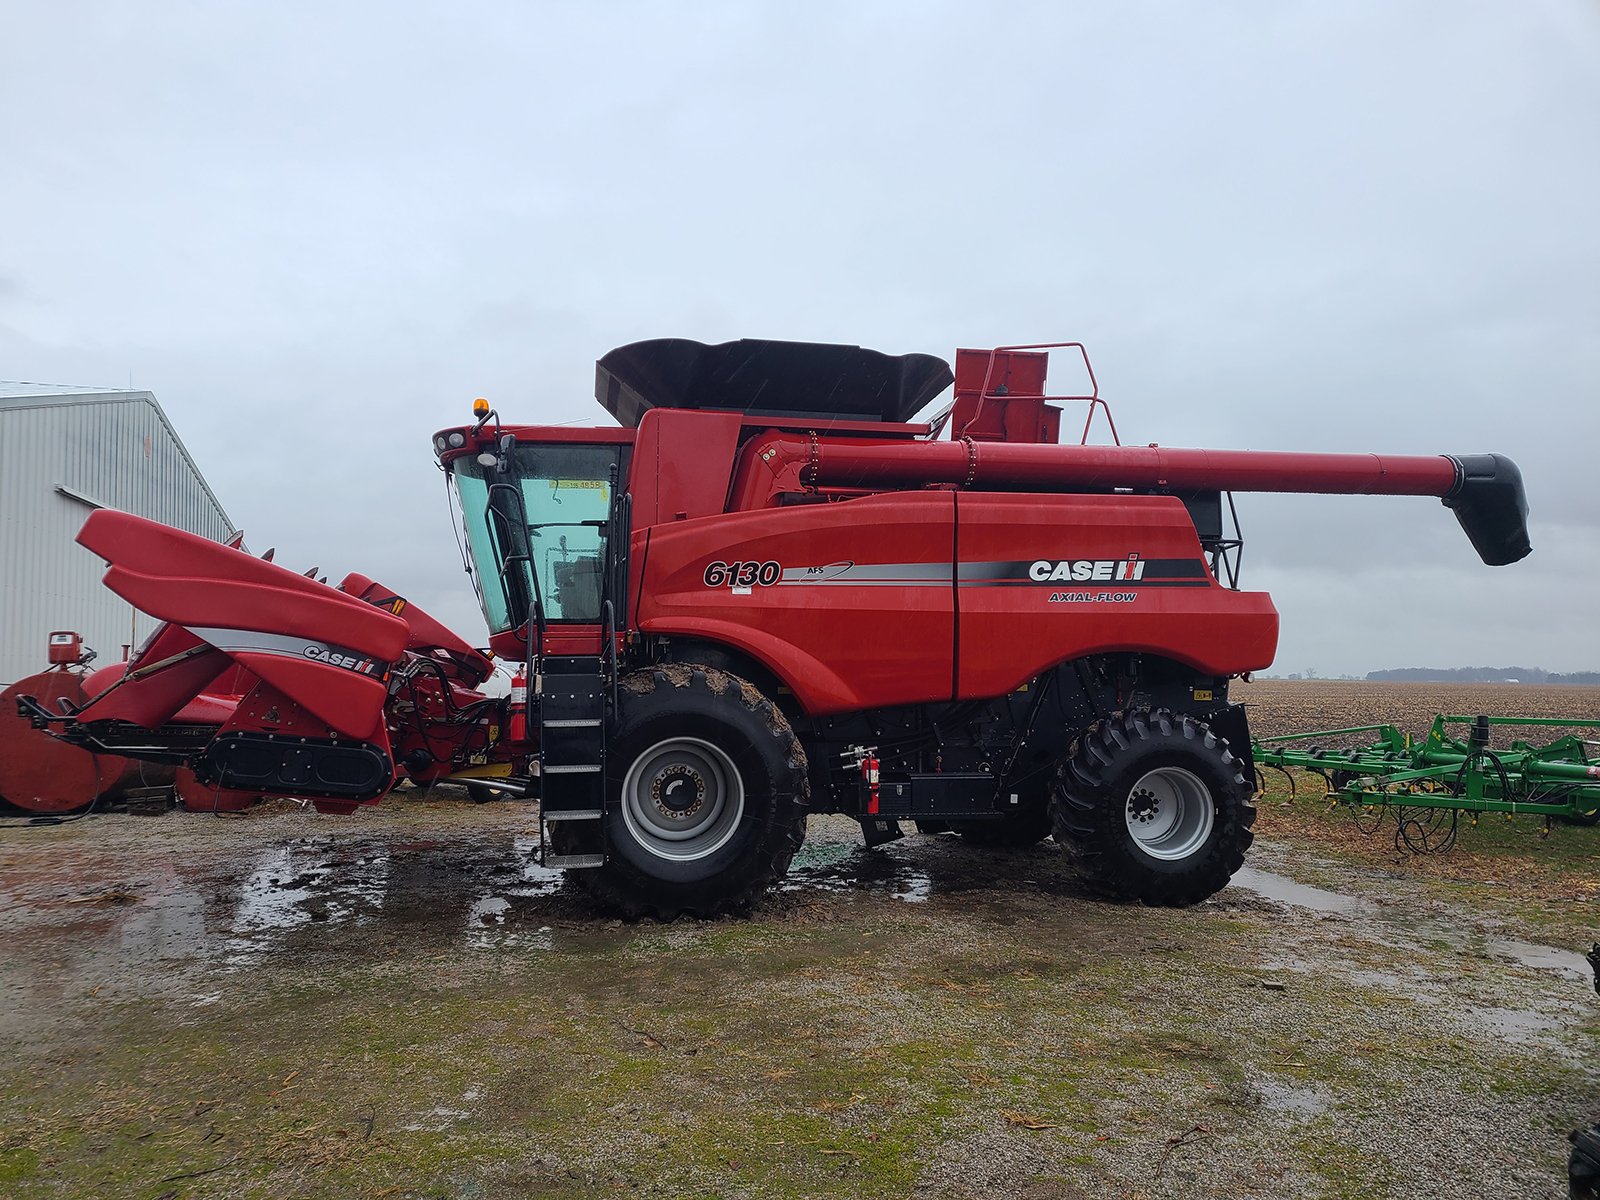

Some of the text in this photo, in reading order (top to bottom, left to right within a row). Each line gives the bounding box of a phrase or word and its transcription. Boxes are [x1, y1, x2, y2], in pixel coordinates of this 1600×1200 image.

[703, 561, 781, 587] 6130
[1029, 560, 1114, 582] CASE
[1048, 592, 1137, 603] AXIAL-FLOW
[303, 646, 356, 669] CASE
